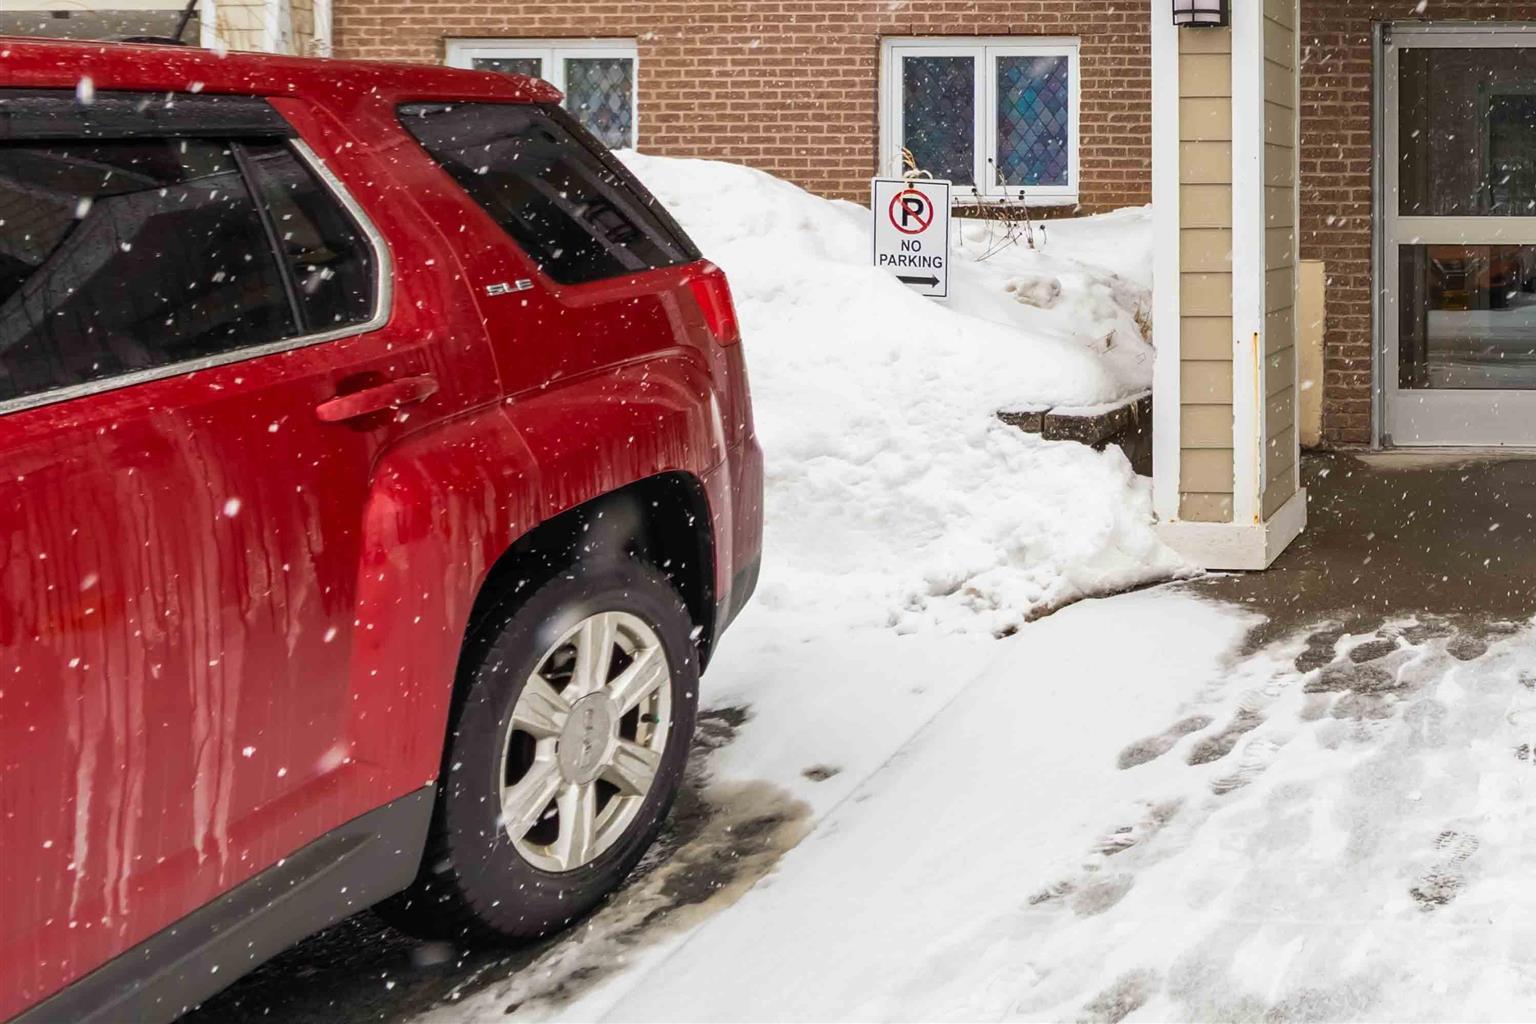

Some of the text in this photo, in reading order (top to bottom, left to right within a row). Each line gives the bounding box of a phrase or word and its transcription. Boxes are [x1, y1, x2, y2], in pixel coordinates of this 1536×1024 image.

[901, 240, 922, 253] NO
[879, 254, 943, 269] PARKING
[486, 278, 535, 296] SLE
